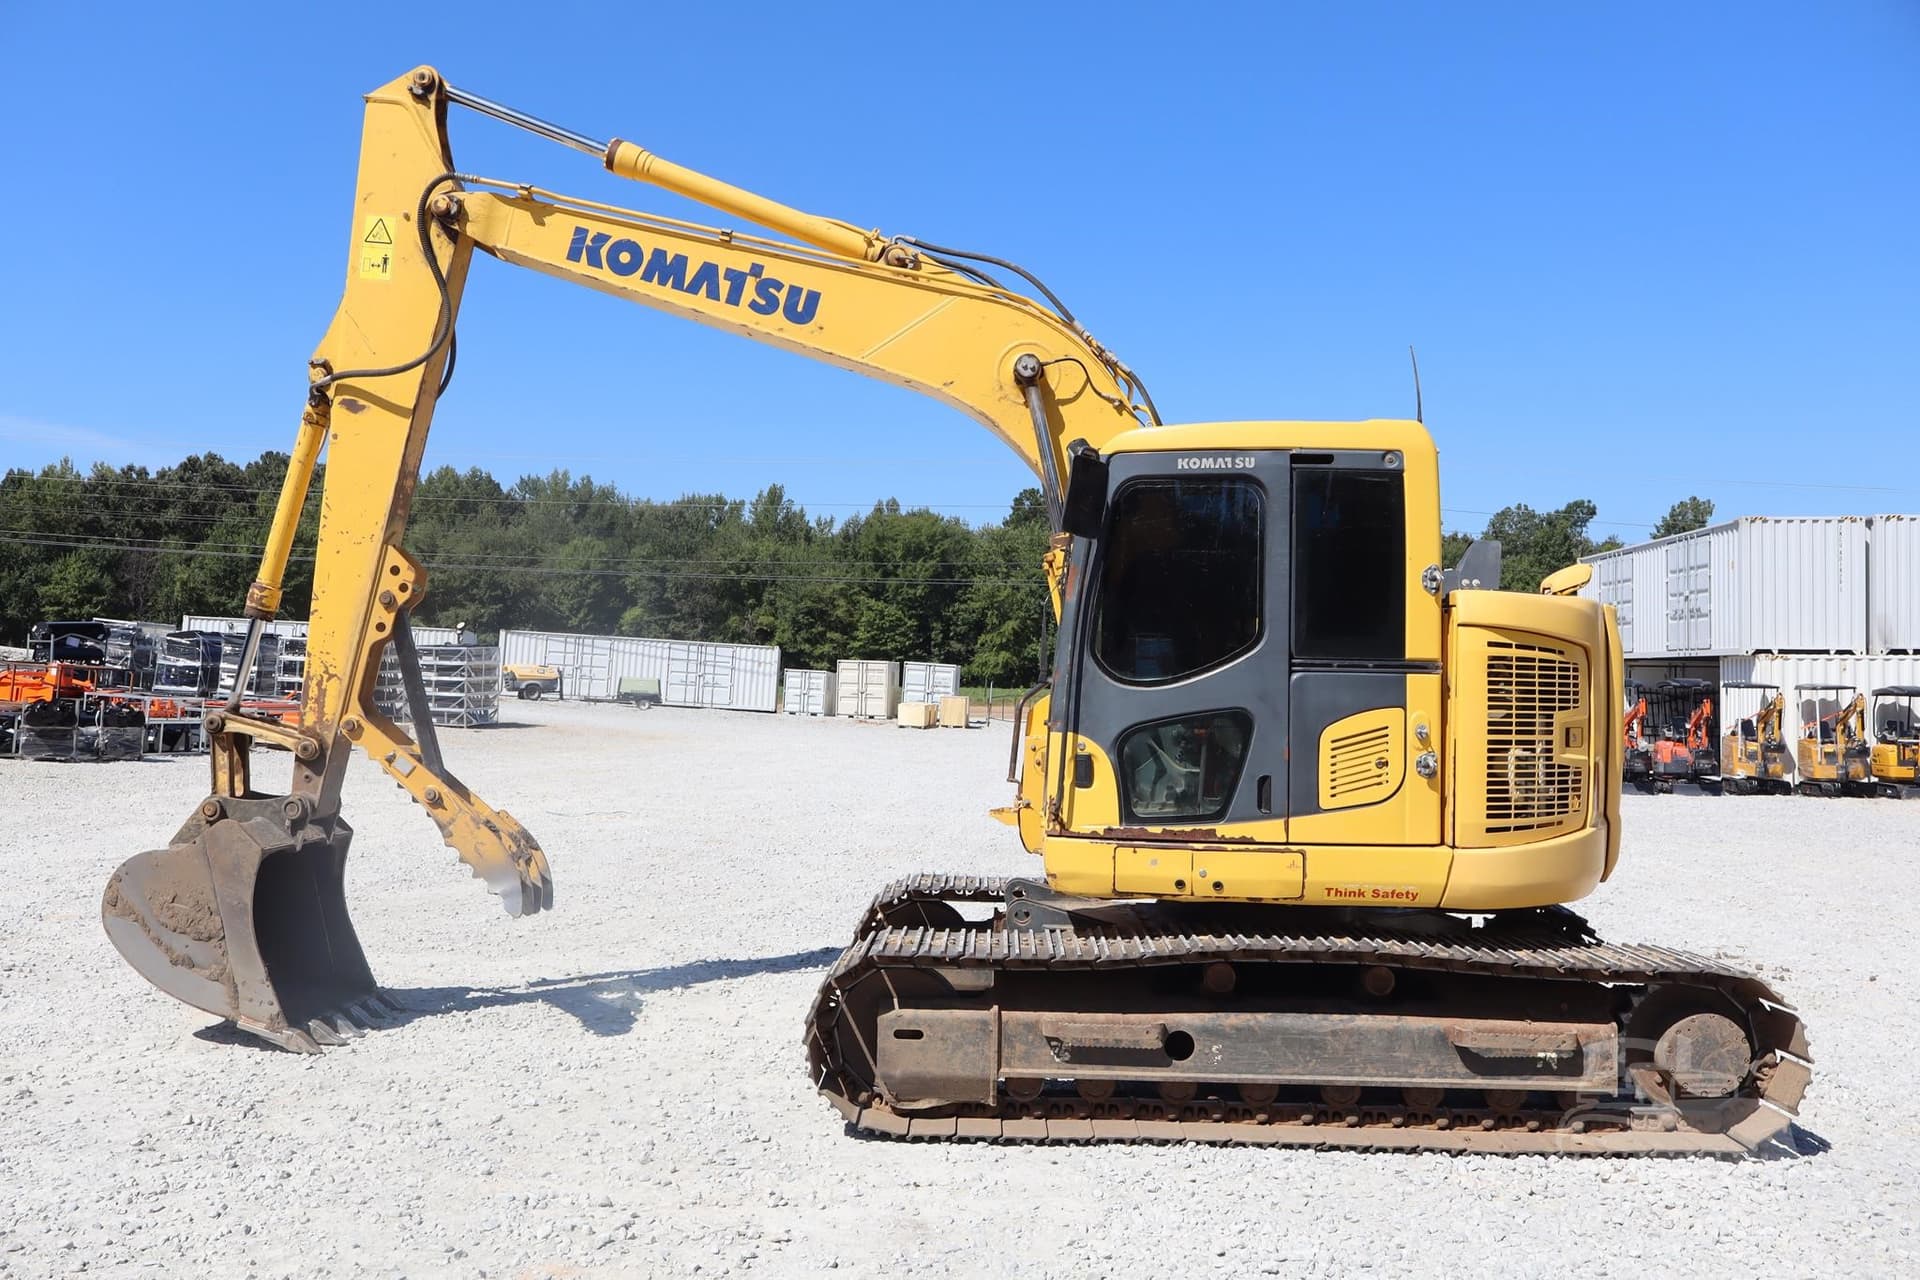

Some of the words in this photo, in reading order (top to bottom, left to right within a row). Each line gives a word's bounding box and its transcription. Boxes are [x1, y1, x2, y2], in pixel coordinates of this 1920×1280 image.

[567, 226, 822, 325] KOMATSU
[1177, 457, 1256, 469] KOMATSU
[1325, 887, 1366, 899] Think
[1371, 888, 1419, 902] Safety
